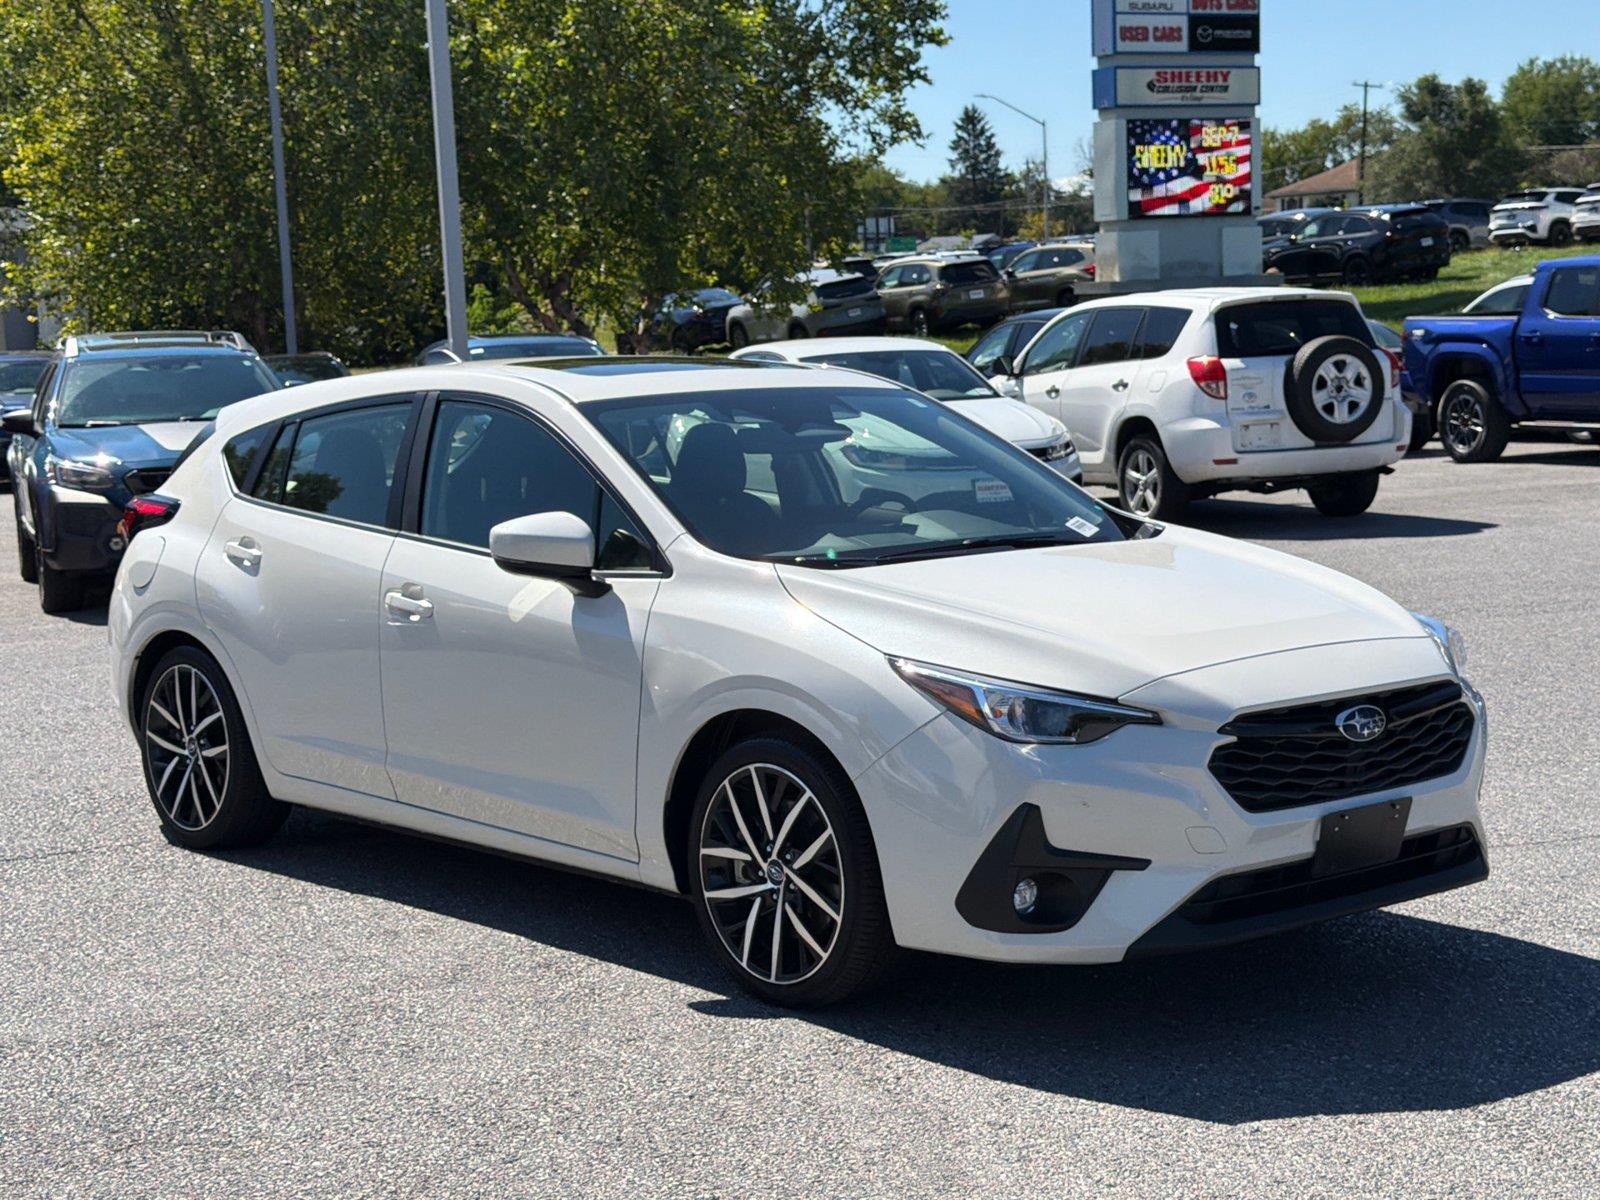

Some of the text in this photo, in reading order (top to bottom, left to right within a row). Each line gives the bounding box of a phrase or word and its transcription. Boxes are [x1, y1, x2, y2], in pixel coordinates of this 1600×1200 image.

[1119, 26, 1183, 42] USED CARS
[1155, 70, 1231, 83] SHEEHY
[1135, 144, 1187, 168] SHEEHY
